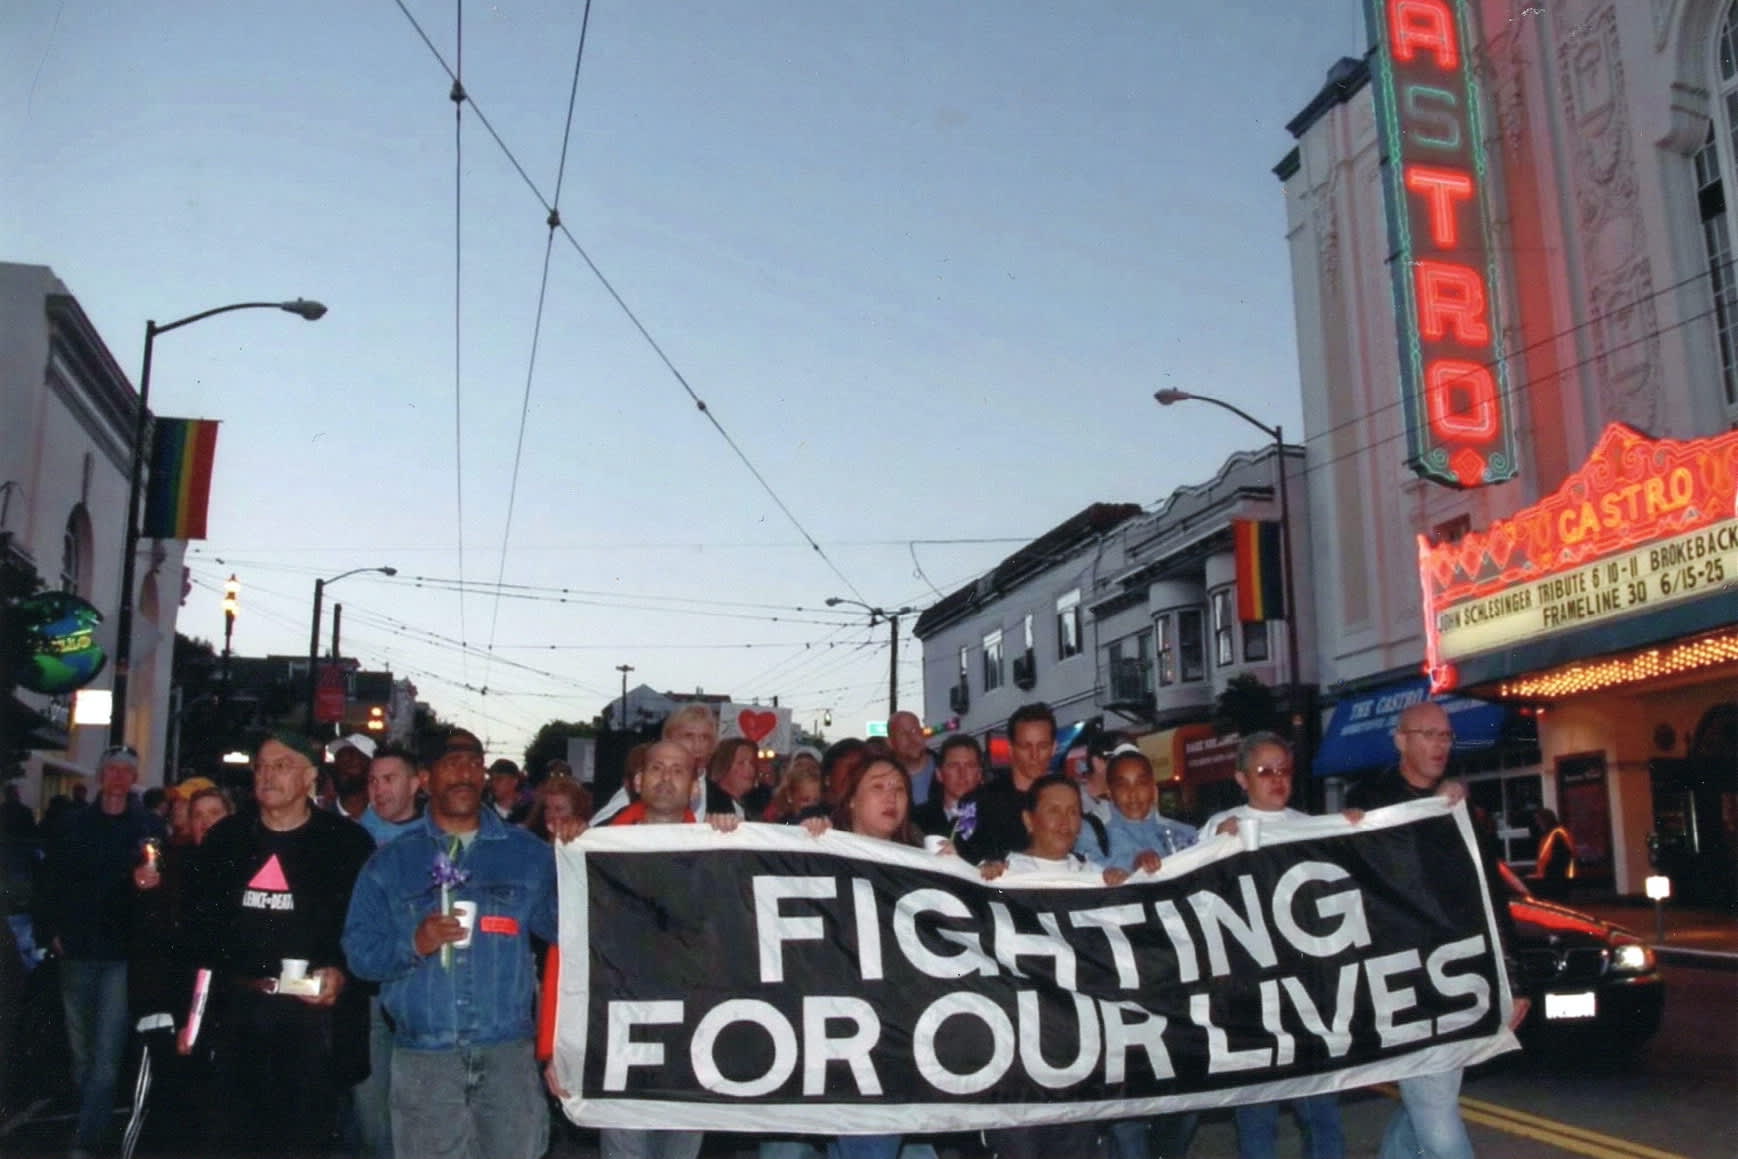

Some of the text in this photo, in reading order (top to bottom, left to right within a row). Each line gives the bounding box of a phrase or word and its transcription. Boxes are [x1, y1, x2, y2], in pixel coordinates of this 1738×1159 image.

[1558, 467, 1693, 544] CASTRO
[1464, 588, 1532, 625] SCHLESINGER
[1538, 573, 1586, 602] TRIBUTE
[1650, 526, 1738, 572] BROKEBACK
[1543, 557, 1725, 627] FRAMELINE 30 6/15-25
[752, 860, 1371, 990] FIGHTING
[603, 934, 1492, 1098] FOR OUR LIVES
